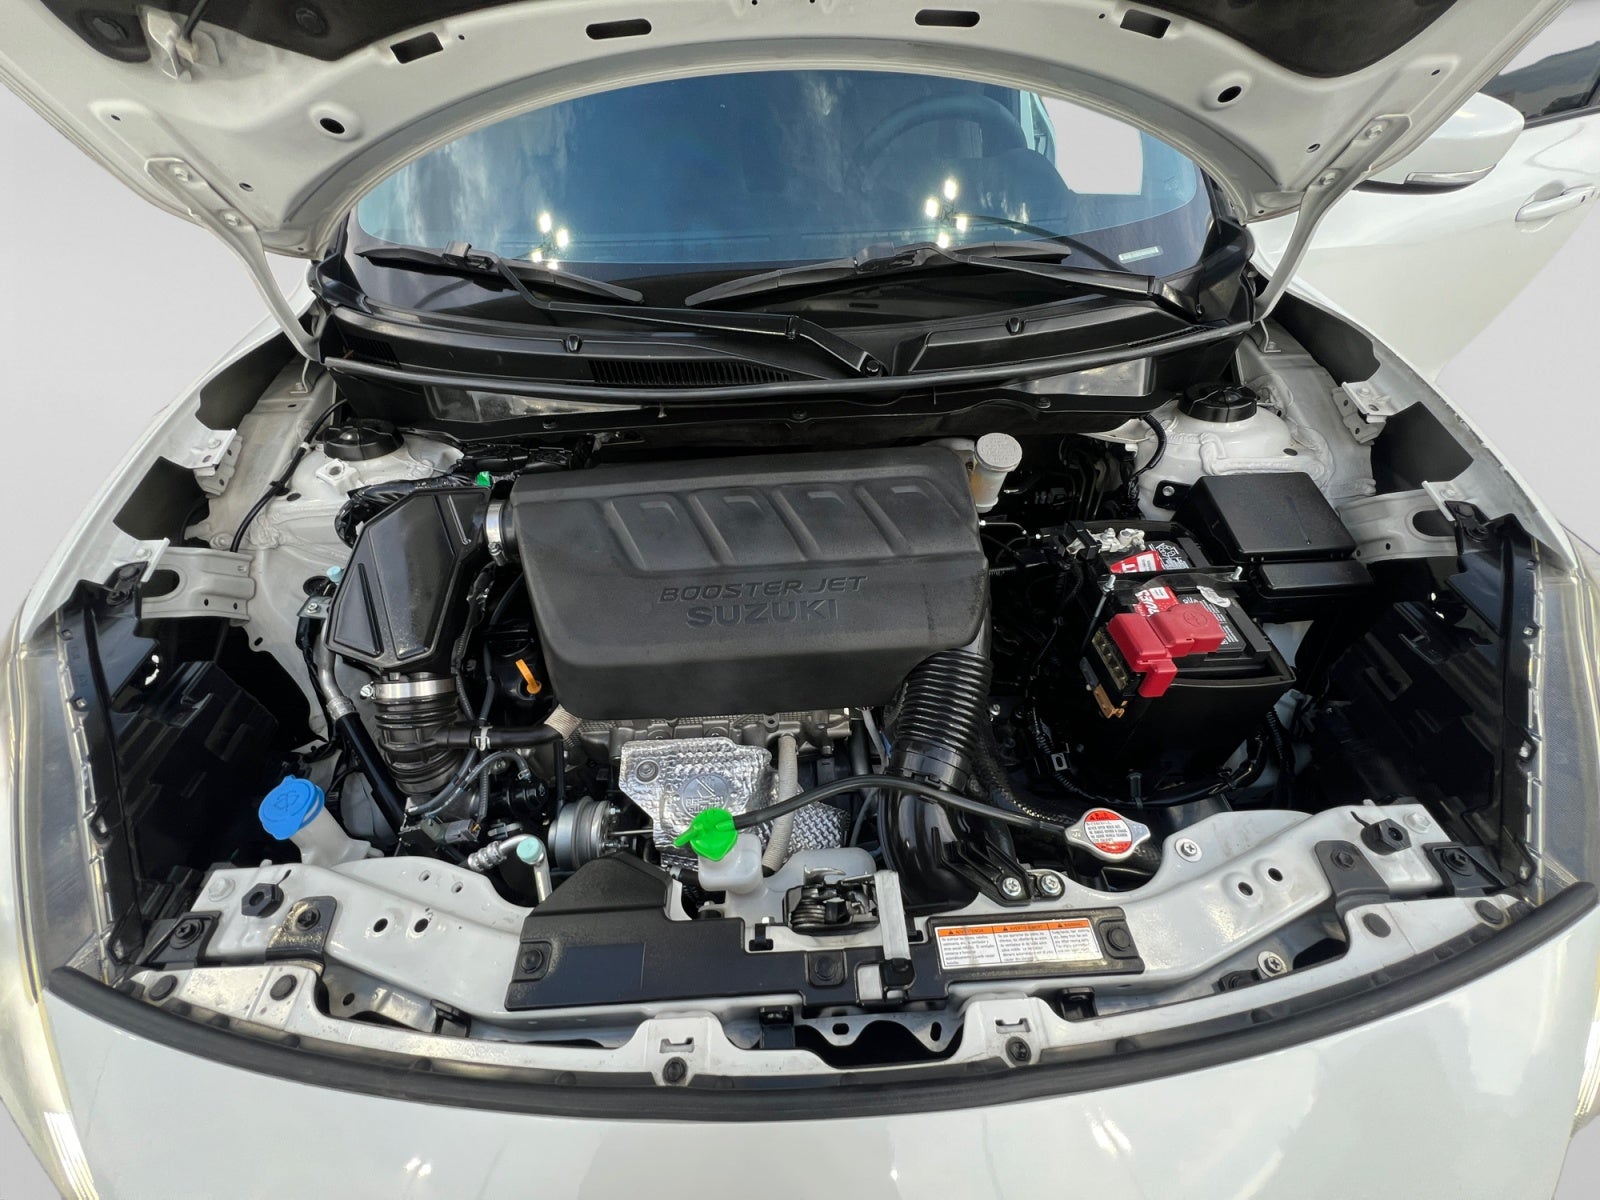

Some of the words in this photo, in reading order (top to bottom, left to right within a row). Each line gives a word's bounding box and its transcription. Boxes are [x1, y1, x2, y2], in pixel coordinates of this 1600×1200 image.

[659, 579, 804, 603] BOOSTER
[810, 576, 868, 593] JET
[686, 599, 839, 628] SUZUKI
